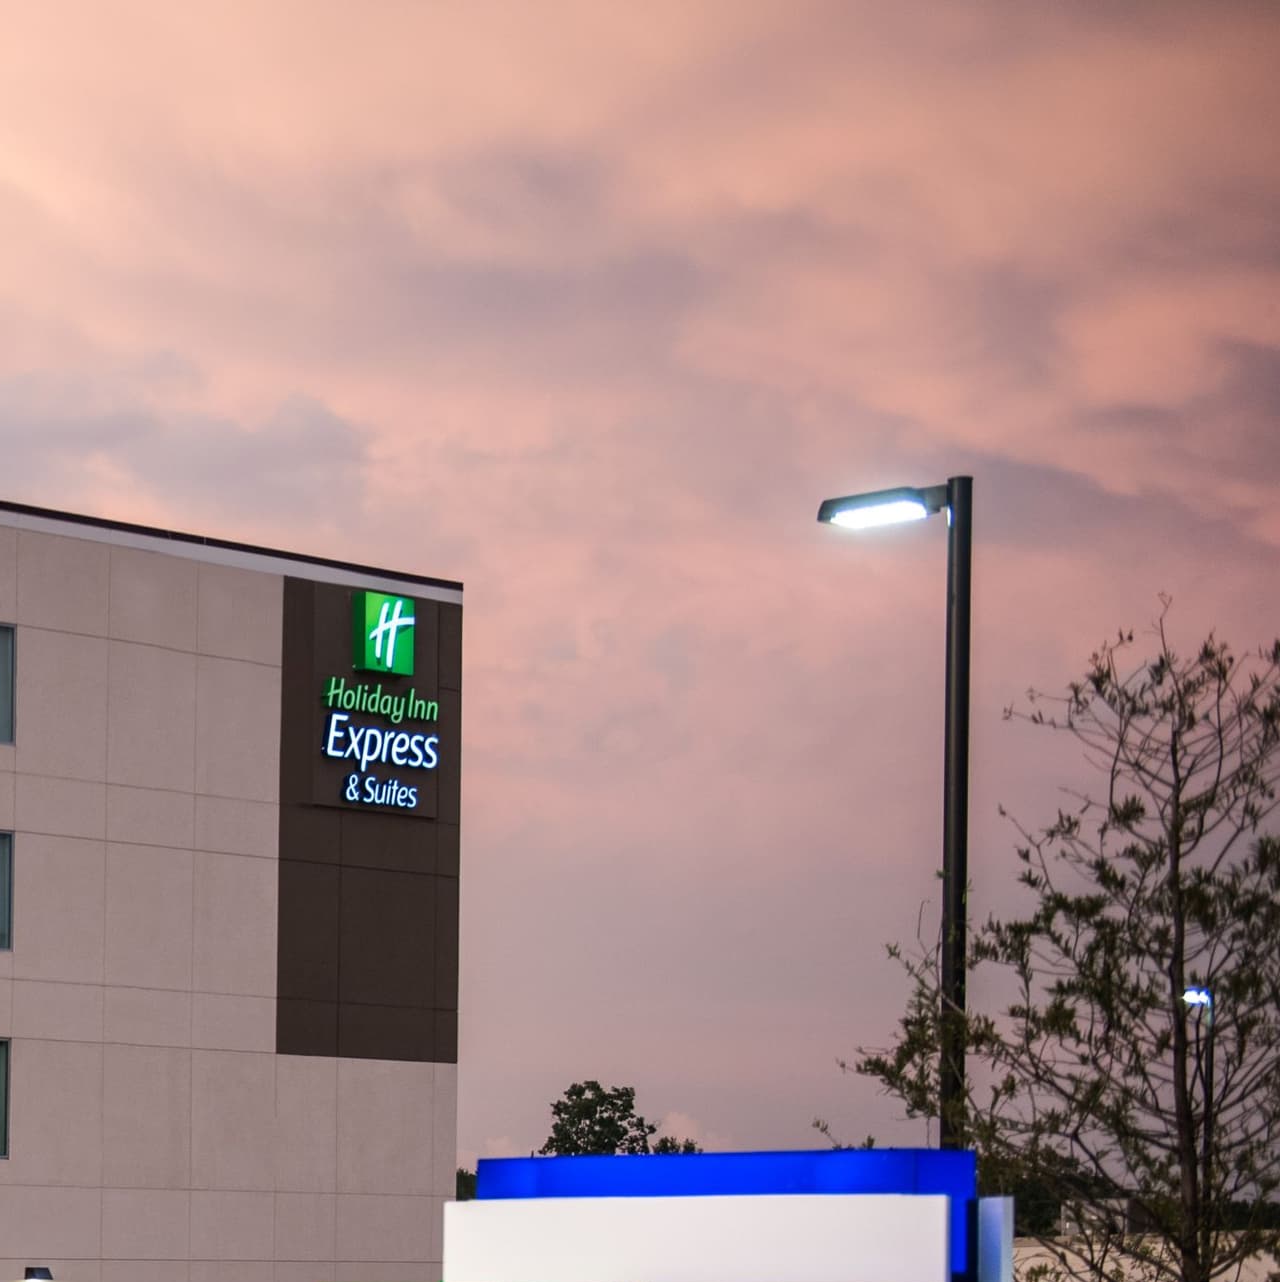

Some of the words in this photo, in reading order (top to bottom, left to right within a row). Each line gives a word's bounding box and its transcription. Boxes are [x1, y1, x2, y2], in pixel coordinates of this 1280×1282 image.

[327, 676, 405, 724] Holiday
[409, 688, 439, 721] Inn
[326, 713, 439, 772] Express
[345, 774, 360, 801] &
[363, 776, 417, 808] Suites
